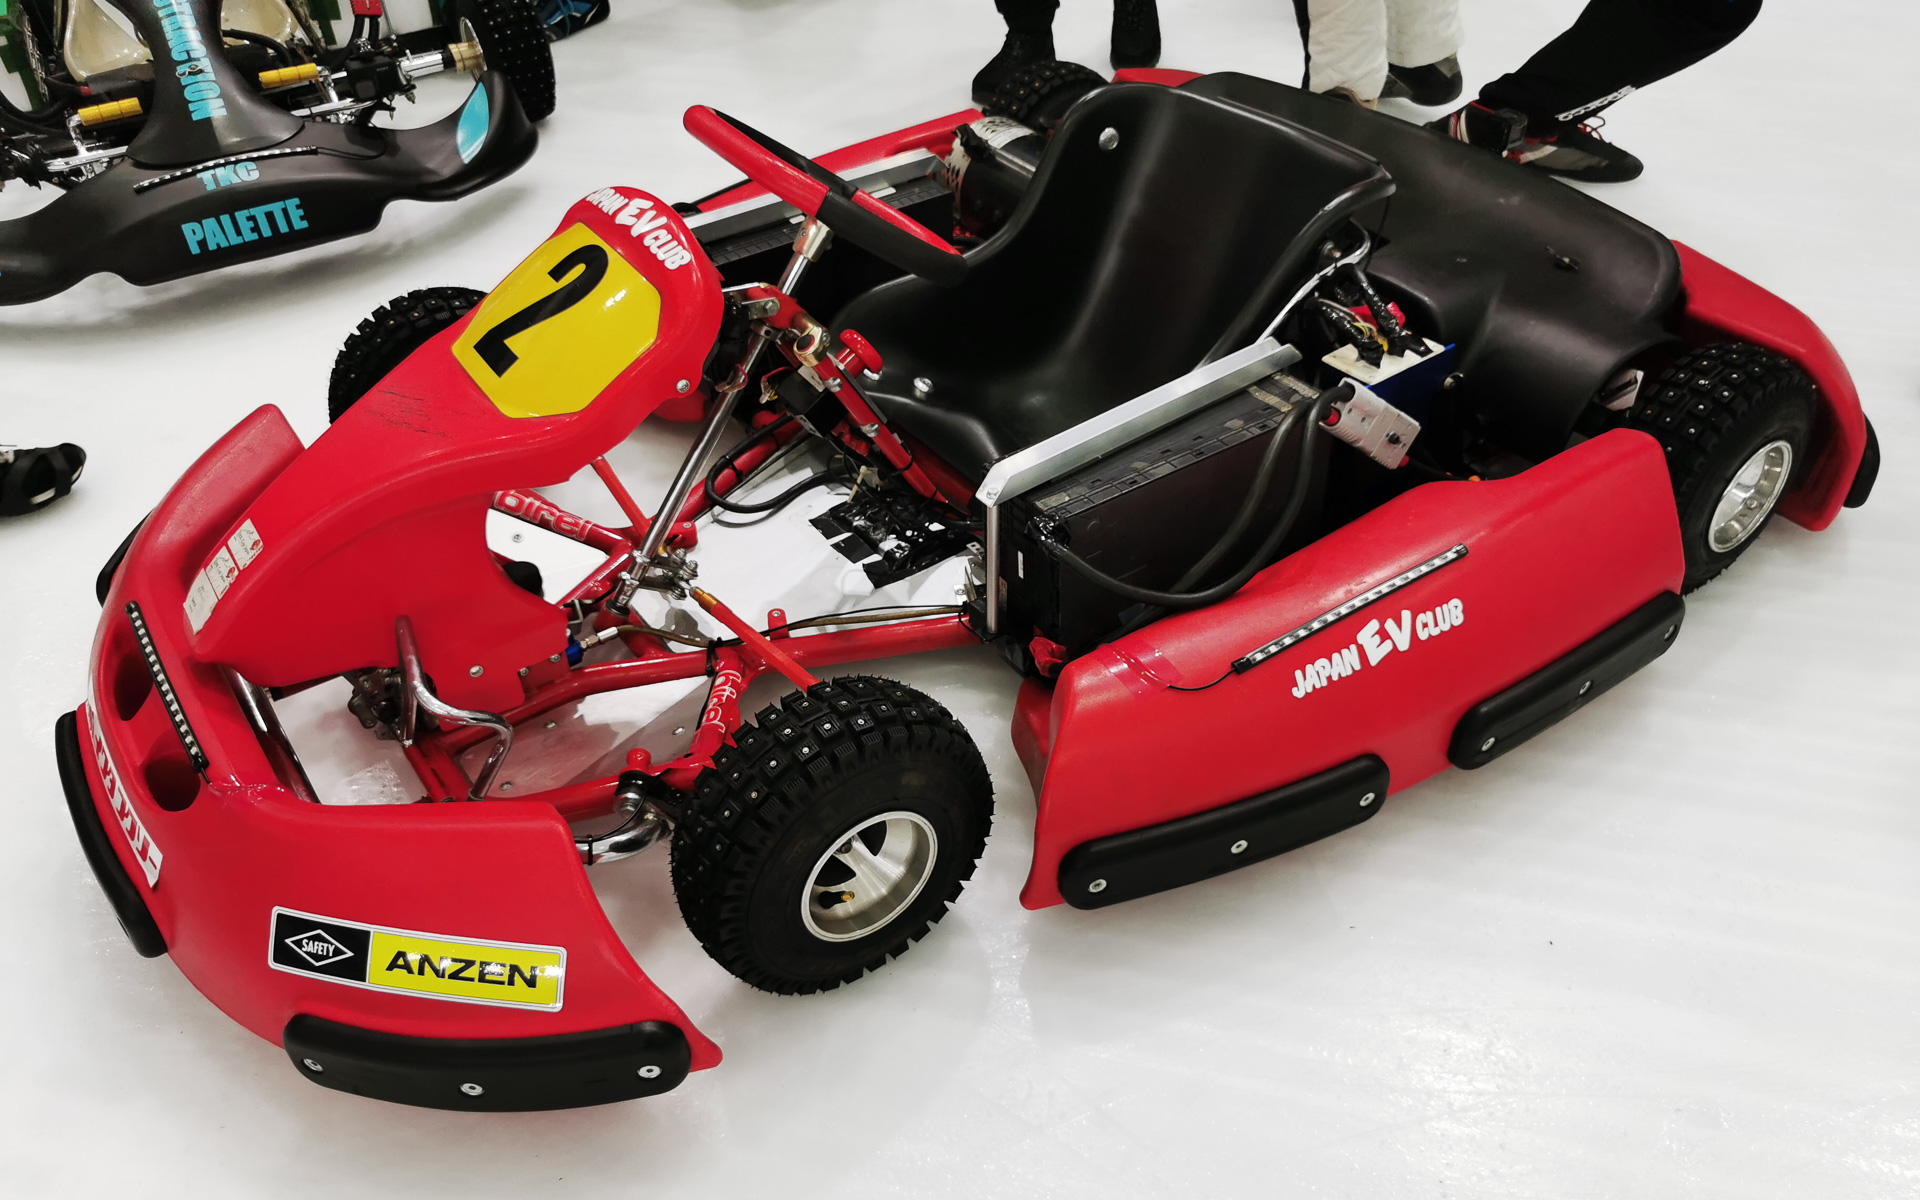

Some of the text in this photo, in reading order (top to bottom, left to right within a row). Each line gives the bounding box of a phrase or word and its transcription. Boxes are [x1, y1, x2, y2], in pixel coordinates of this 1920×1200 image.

[196, 161, 260, 191] TKC
[181, 197, 309, 255] PALETTE
[586, 187, 691, 270] JAPAN EV CLUB
[473, 244, 609, 378] 2
[493, 490, 594, 542] birel
[1291, 598, 1464, 698] JAPAN EV CLUB
[301, 938, 335, 957] SAFETY
[385, 950, 538, 988] ANZEN
